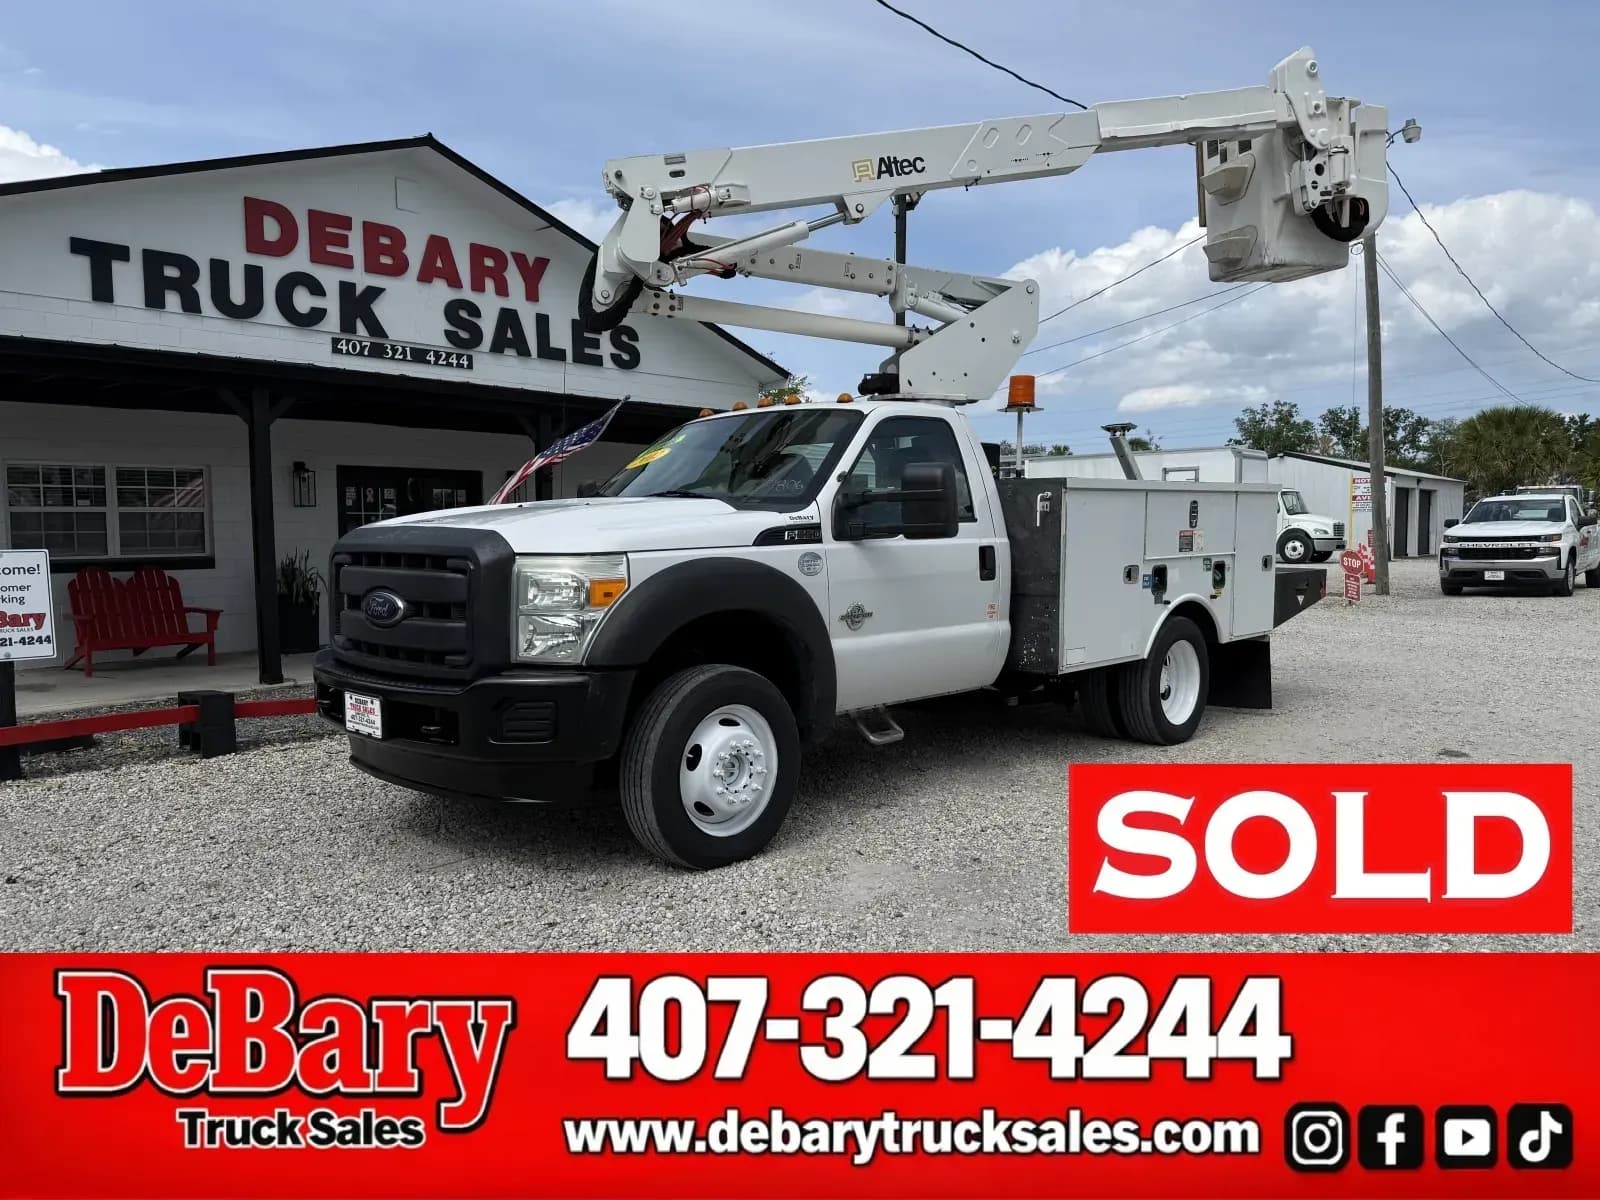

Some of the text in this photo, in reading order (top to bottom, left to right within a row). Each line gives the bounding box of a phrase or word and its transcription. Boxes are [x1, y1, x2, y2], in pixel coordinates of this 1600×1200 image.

[876, 155, 926, 180] Altec
[243, 196, 551, 303] DEBARY
[69, 236, 641, 370] TRUCK SALES
[337, 339, 469, 368] 407 321 4244
[1343, 557, 1361, 569] STOP
